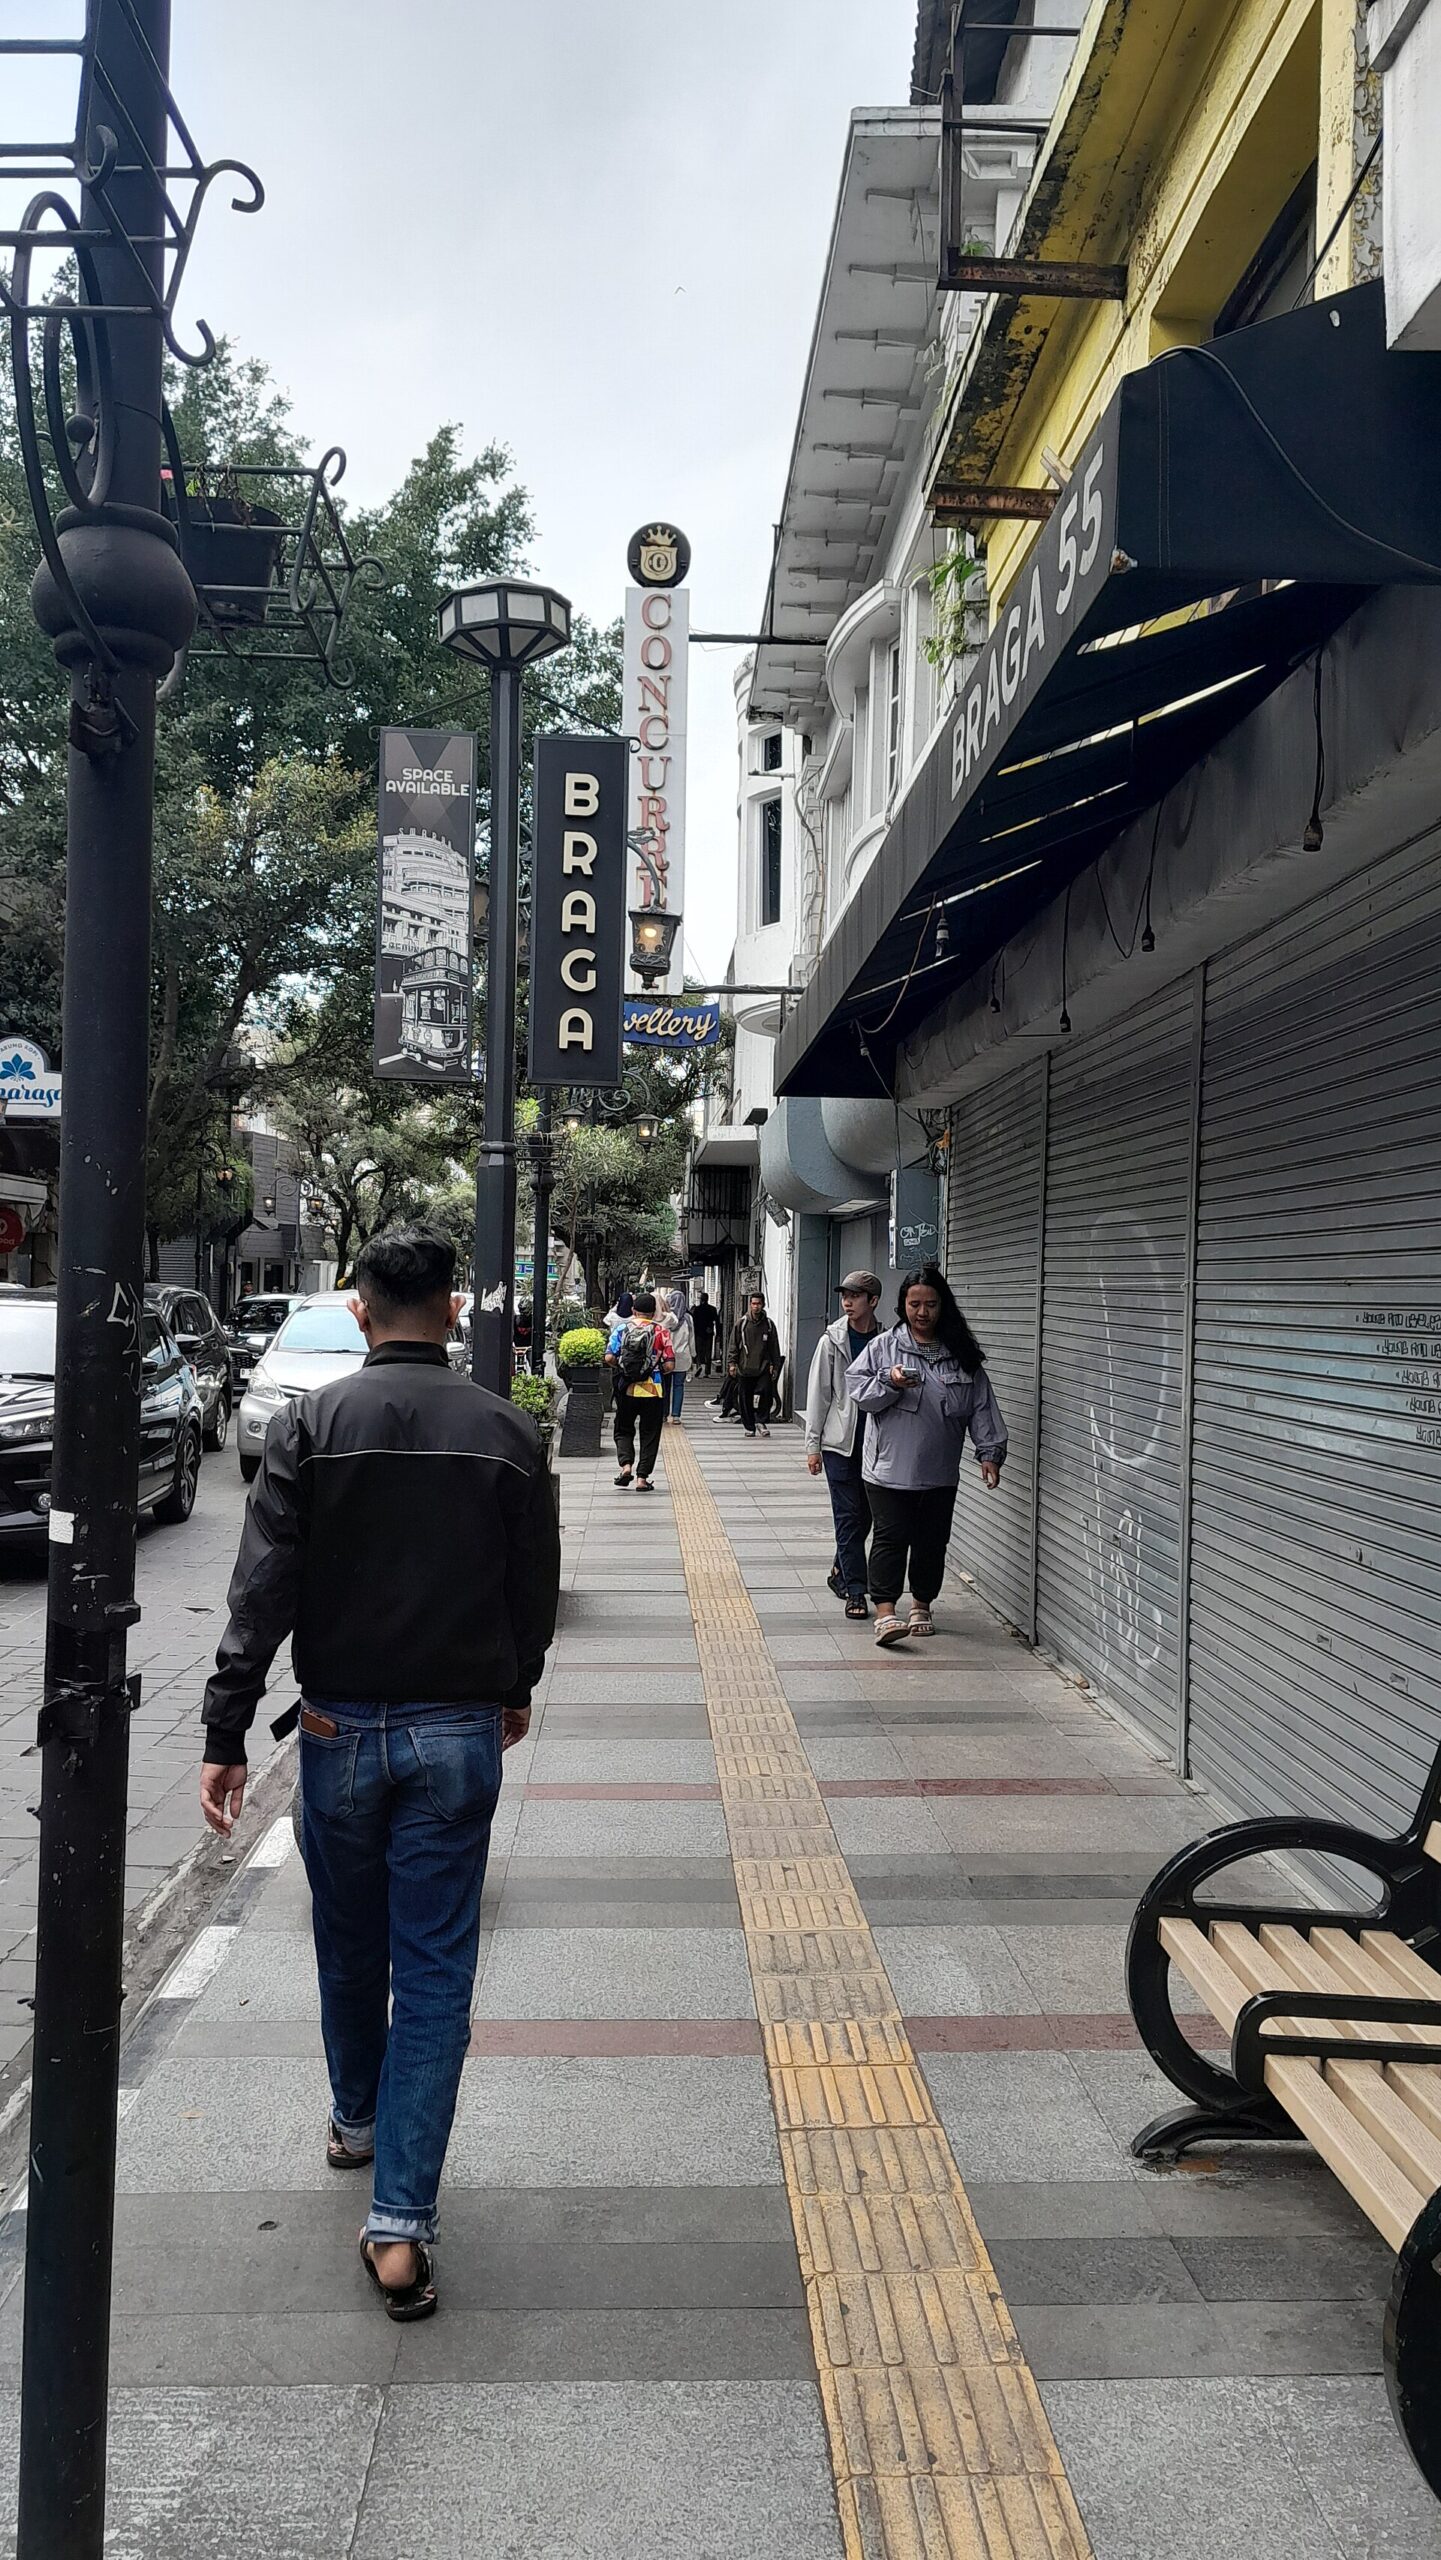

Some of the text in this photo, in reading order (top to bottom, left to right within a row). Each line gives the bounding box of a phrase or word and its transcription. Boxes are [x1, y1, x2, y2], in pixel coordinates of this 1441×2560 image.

[951, 442, 1103, 802] BRAGA 55
[385, 780, 469, 796] AVAILABLE
[402, 768, 453, 782] SPACE
[559, 772, 600, 1051] BRAGA
